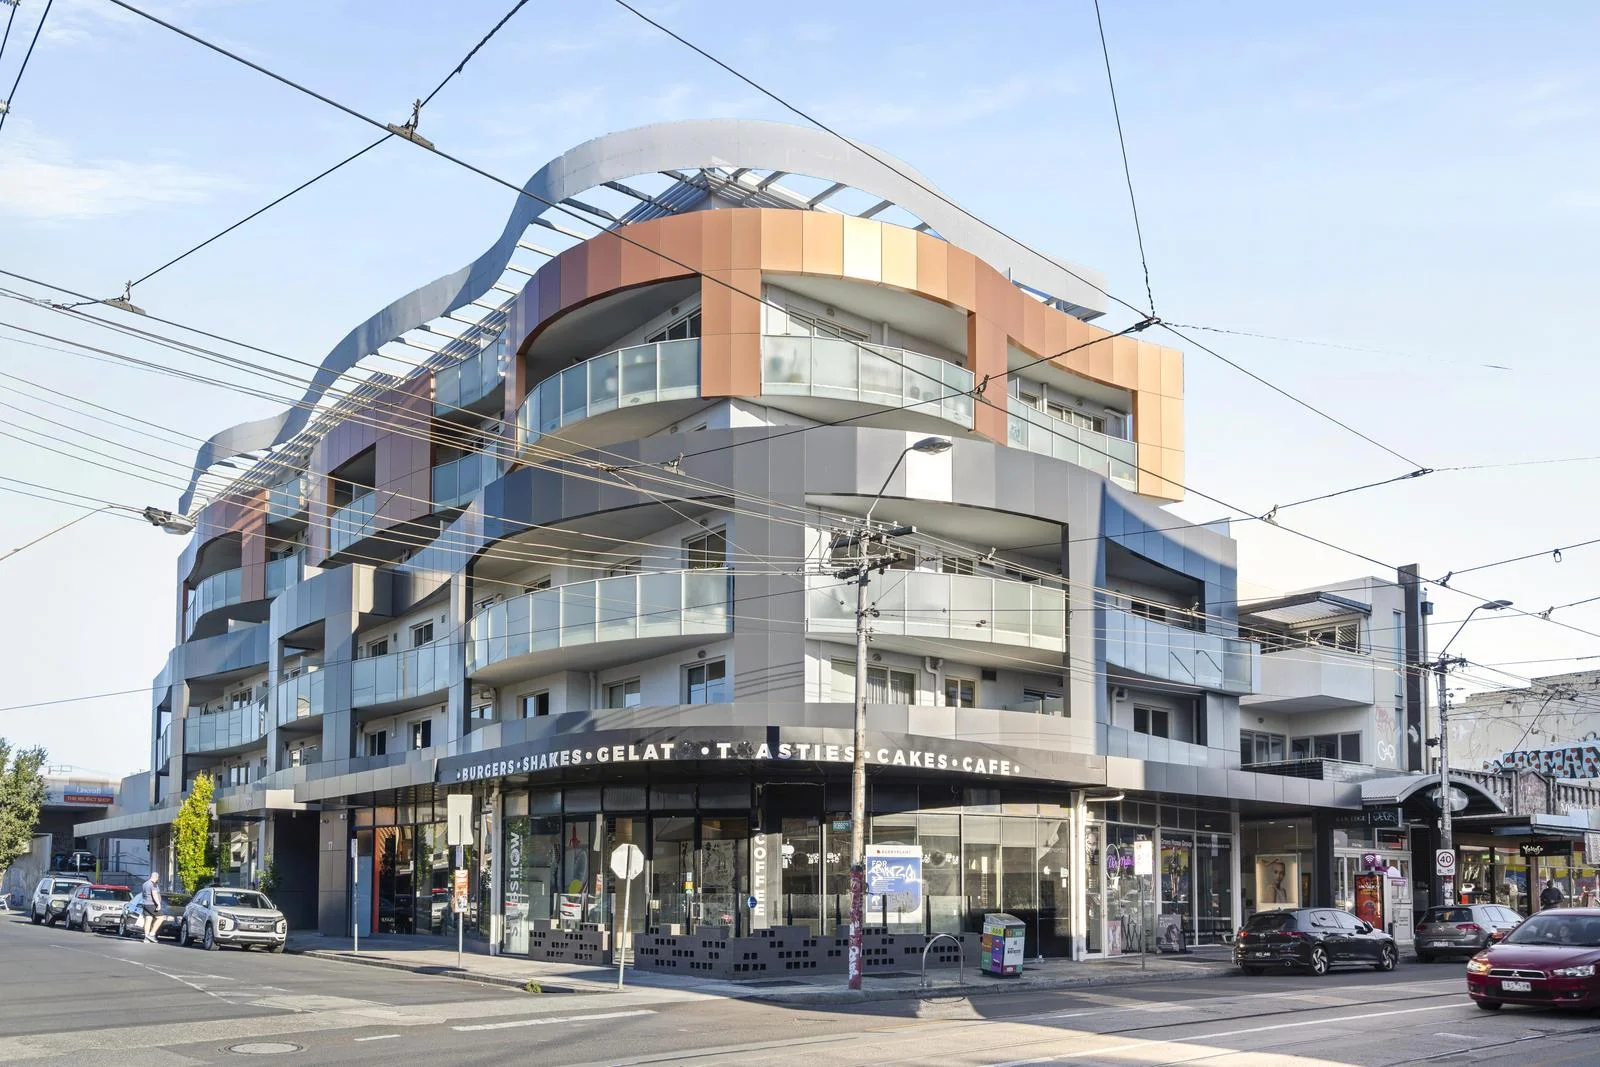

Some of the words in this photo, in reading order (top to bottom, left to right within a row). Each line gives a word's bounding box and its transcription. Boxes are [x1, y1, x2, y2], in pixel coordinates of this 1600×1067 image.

[462, 760, 514, 781] BURGERS
[523, 749, 582, 771] SHAKES
[877, 749, 948, 769] CAKES
[962, 757, 1010, 776] CAFE
[754, 833, 767, 916] COFFEE
[1440, 855, 1451, 863] 40
